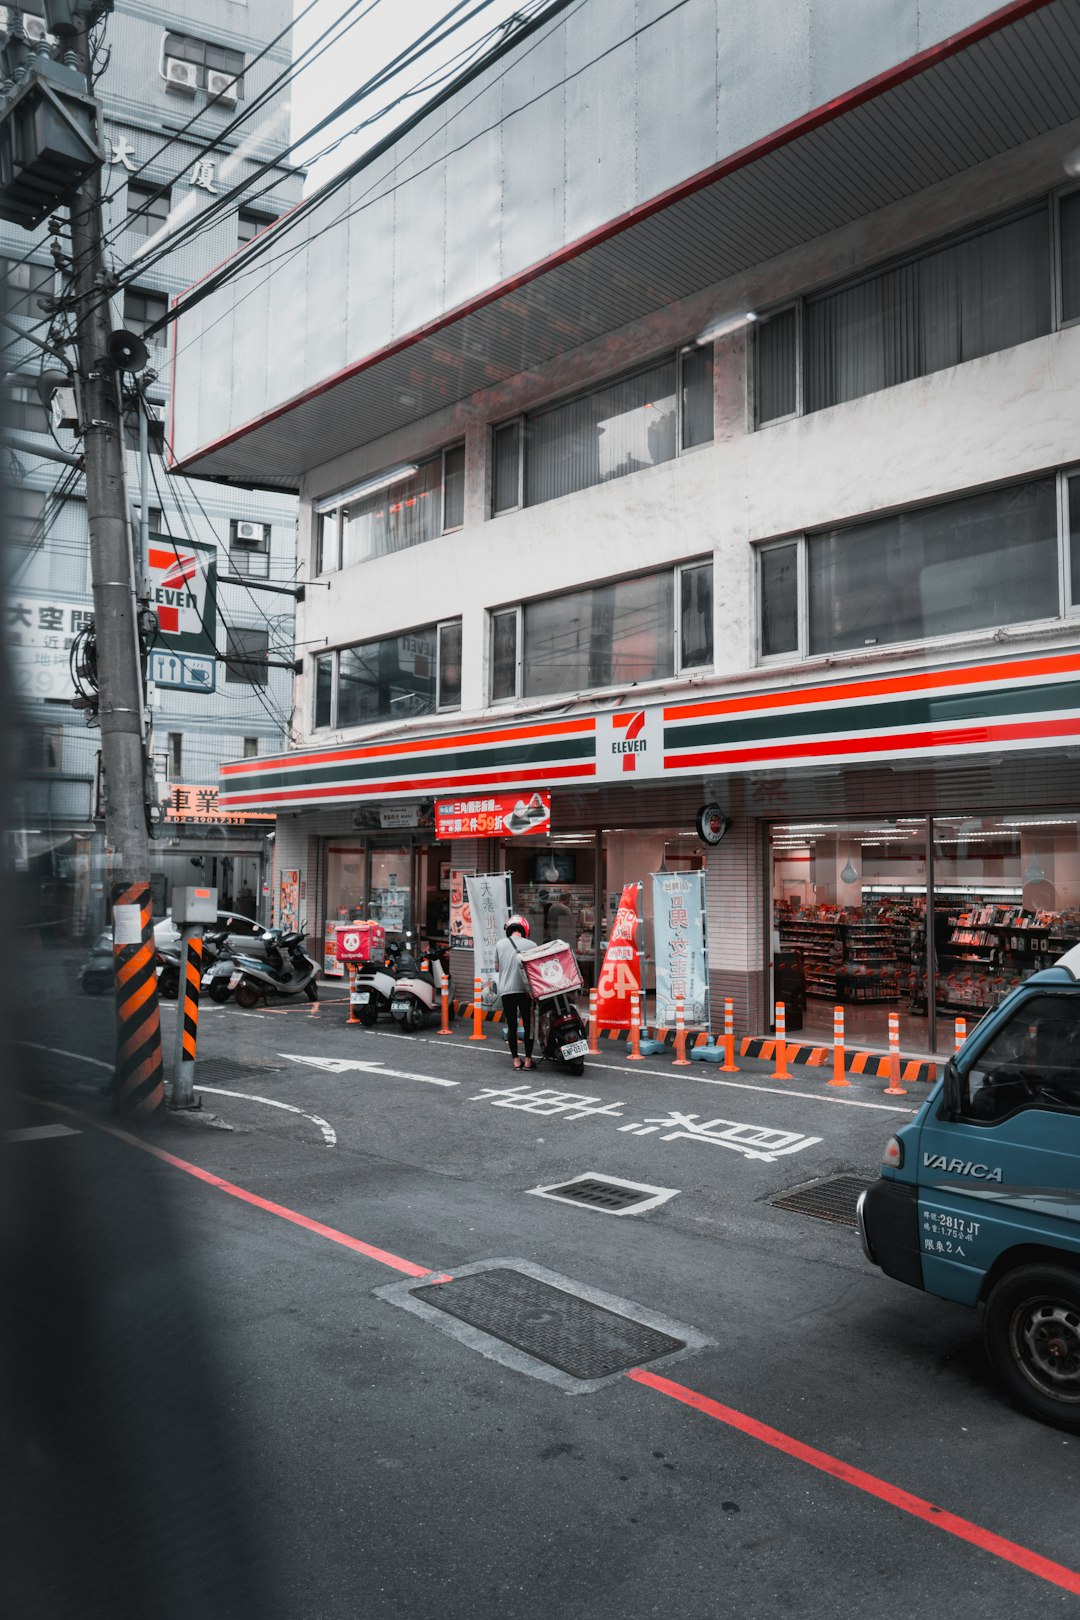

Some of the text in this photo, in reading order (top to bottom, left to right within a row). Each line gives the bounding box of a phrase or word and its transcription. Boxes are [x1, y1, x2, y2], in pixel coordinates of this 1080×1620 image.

[612, 711, 646, 771] 7
[923, 1152, 1002, 1182] VARICA
[967, 1222, 981, 1236] JT
